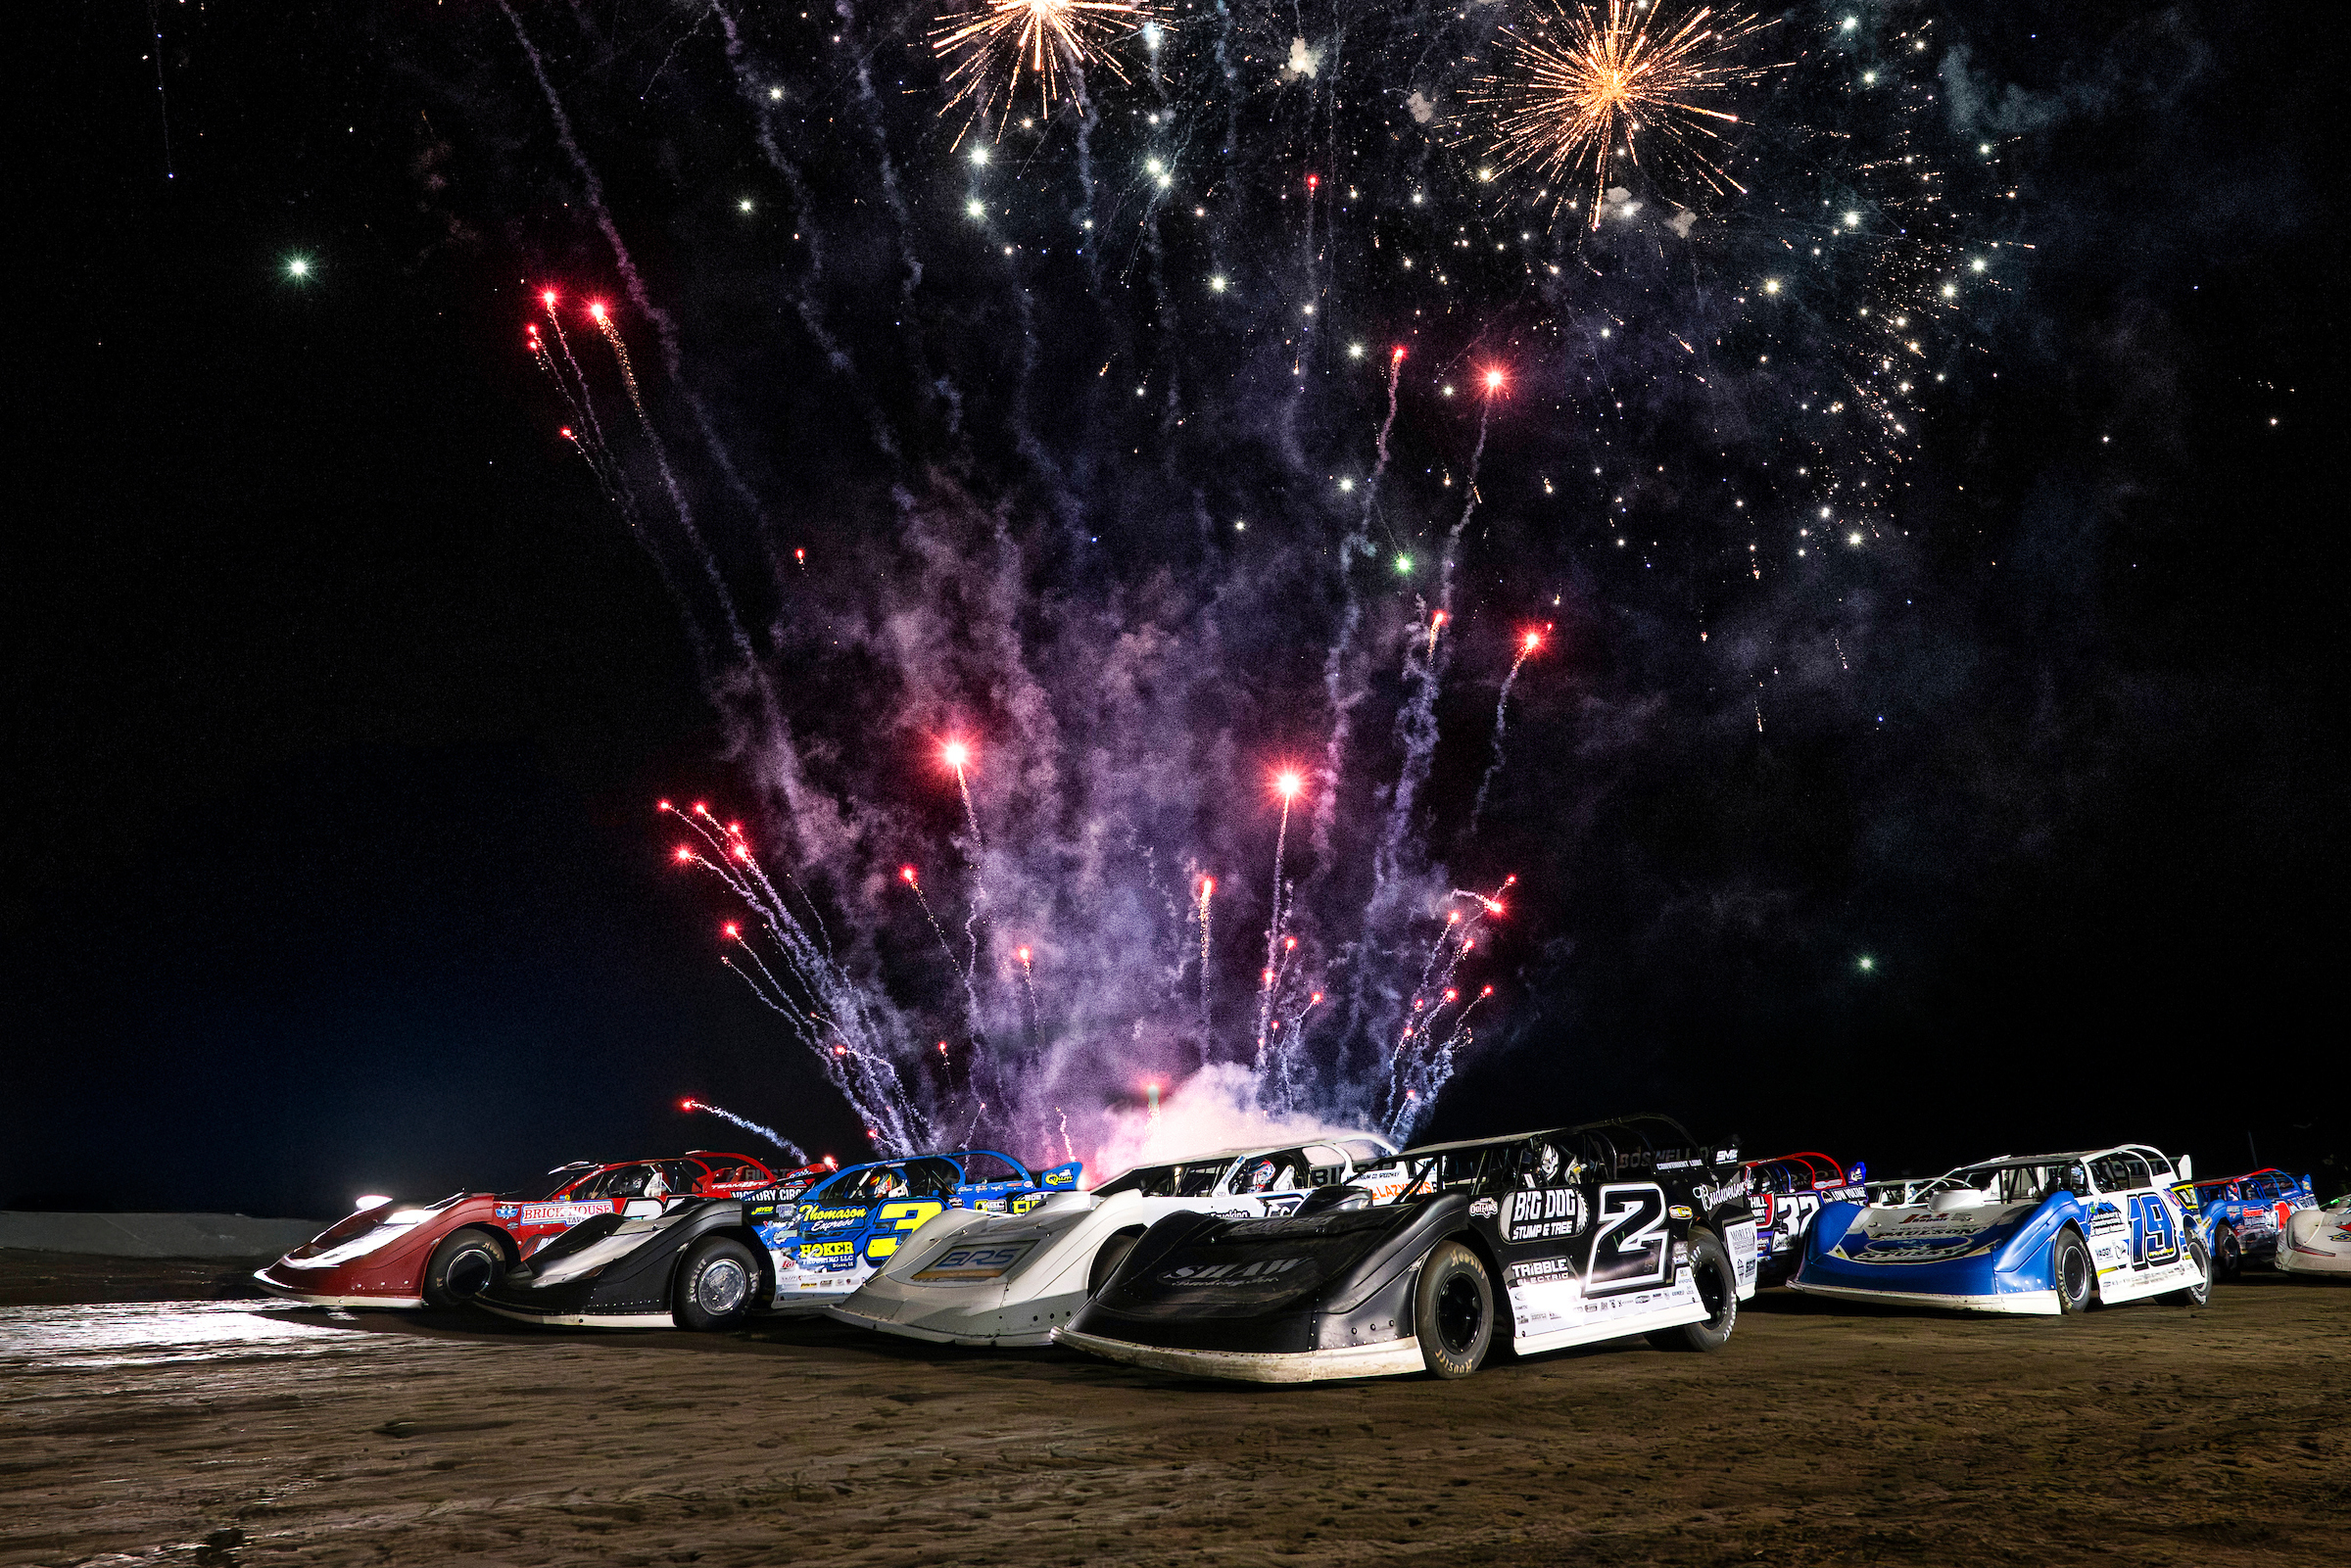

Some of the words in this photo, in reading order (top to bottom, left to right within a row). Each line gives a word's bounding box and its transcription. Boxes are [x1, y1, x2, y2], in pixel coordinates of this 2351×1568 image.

[1512, 1191, 1543, 1222] BIG
[1544, 1189, 1576, 1219] DOG
[1693, 1181, 1747, 1212] Budweiser
[524, 1207, 568, 1220] BRICK
[571, 1205, 612, 1216] HOUSE
[798, 1204, 866, 1222] Thomason
[811, 1218, 854, 1232] Express
[867, 1201, 942, 1259] 3
[1512, 1222, 1542, 1241] STUMP
[1542, 1223, 1551, 1237] &
[1550, 1221, 1573, 1236] TREE
[2128, 1194, 2177, 1264] 19
[1583, 1183, 1669, 1296] 2
[799, 1241, 855, 1259] HOKER
[1516, 1272, 1568, 1286] ELECTRIC
